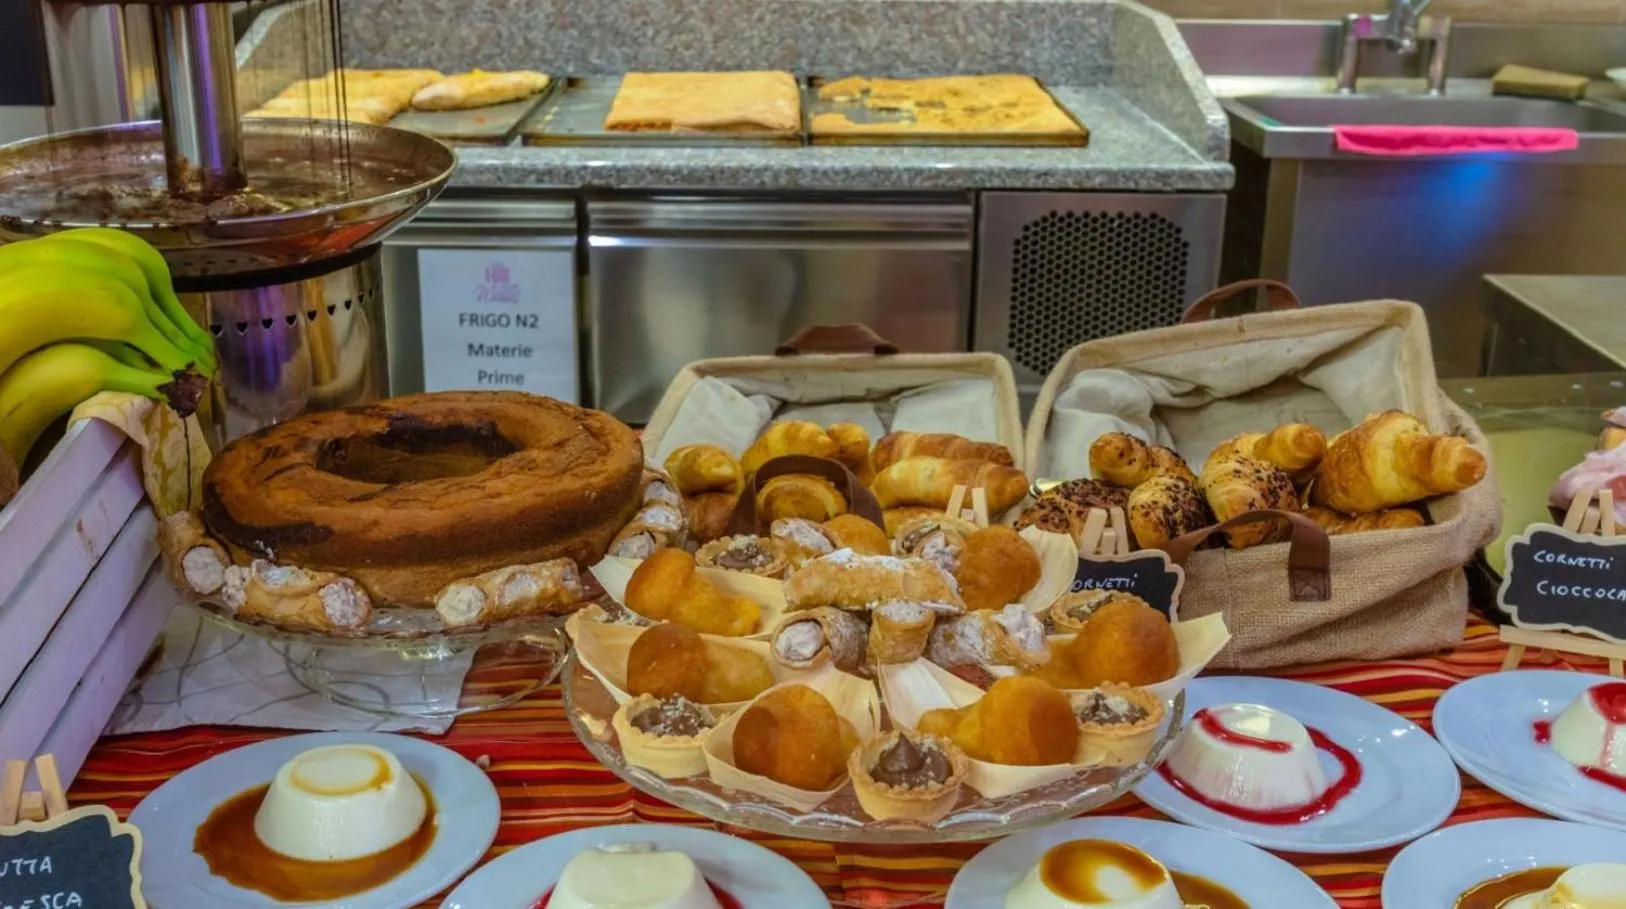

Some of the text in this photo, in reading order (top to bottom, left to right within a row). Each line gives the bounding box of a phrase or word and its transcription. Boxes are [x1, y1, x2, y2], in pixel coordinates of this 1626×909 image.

[458, 313, 539, 329] FRIGO N2
[467, 343, 533, 358] Materie
[478, 370, 525, 385] Prime
